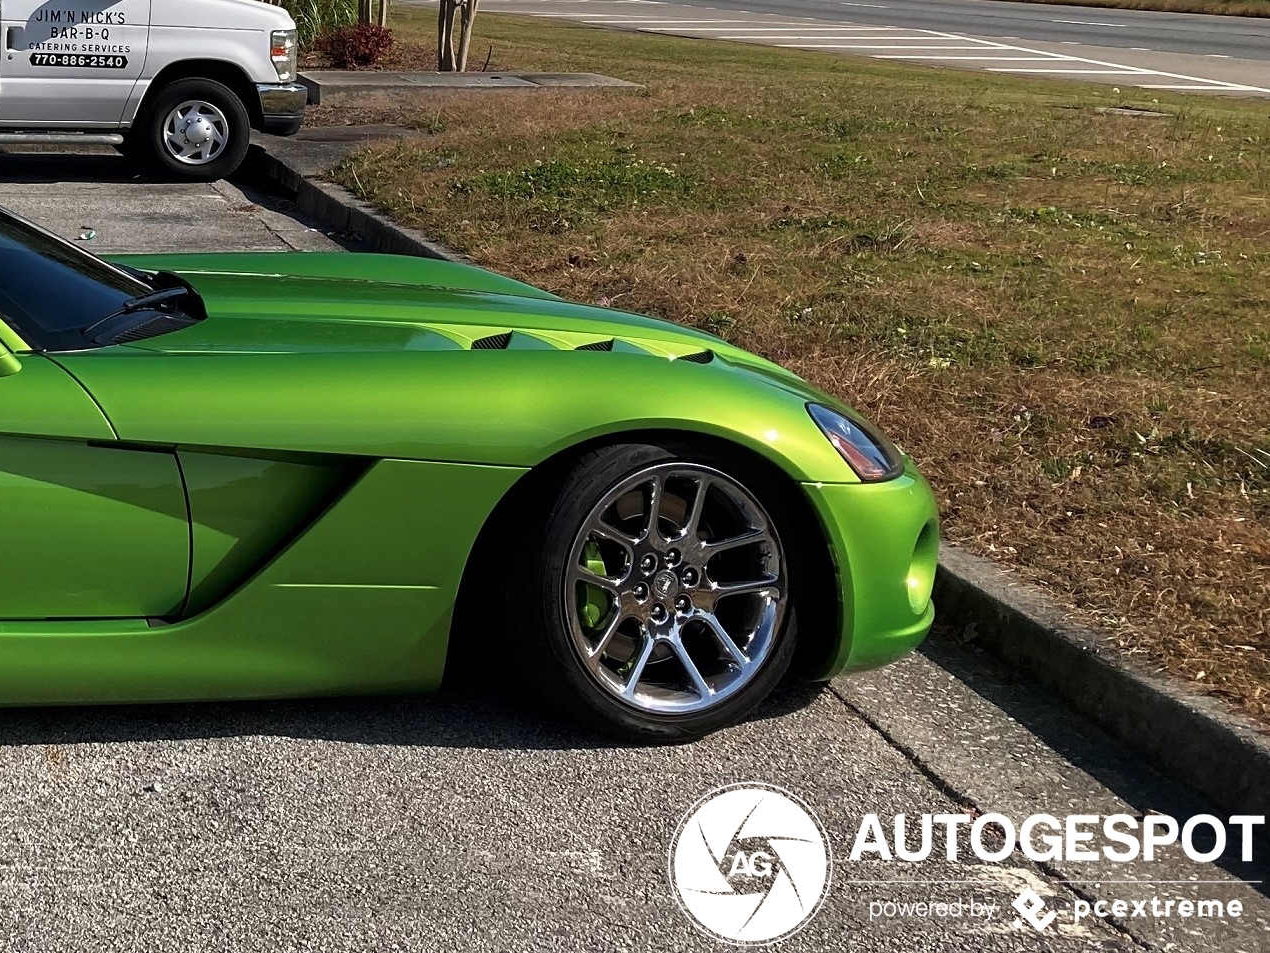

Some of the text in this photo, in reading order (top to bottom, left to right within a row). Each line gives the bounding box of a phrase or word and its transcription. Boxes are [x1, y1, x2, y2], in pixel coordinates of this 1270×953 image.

[81, 10, 126, 24] NICK'S
[50, 26, 110, 41] BAR-B-Q
[29, 42, 131, 53] CATERING SERVICES
[34, 54, 123, 67] 770-886-2540
